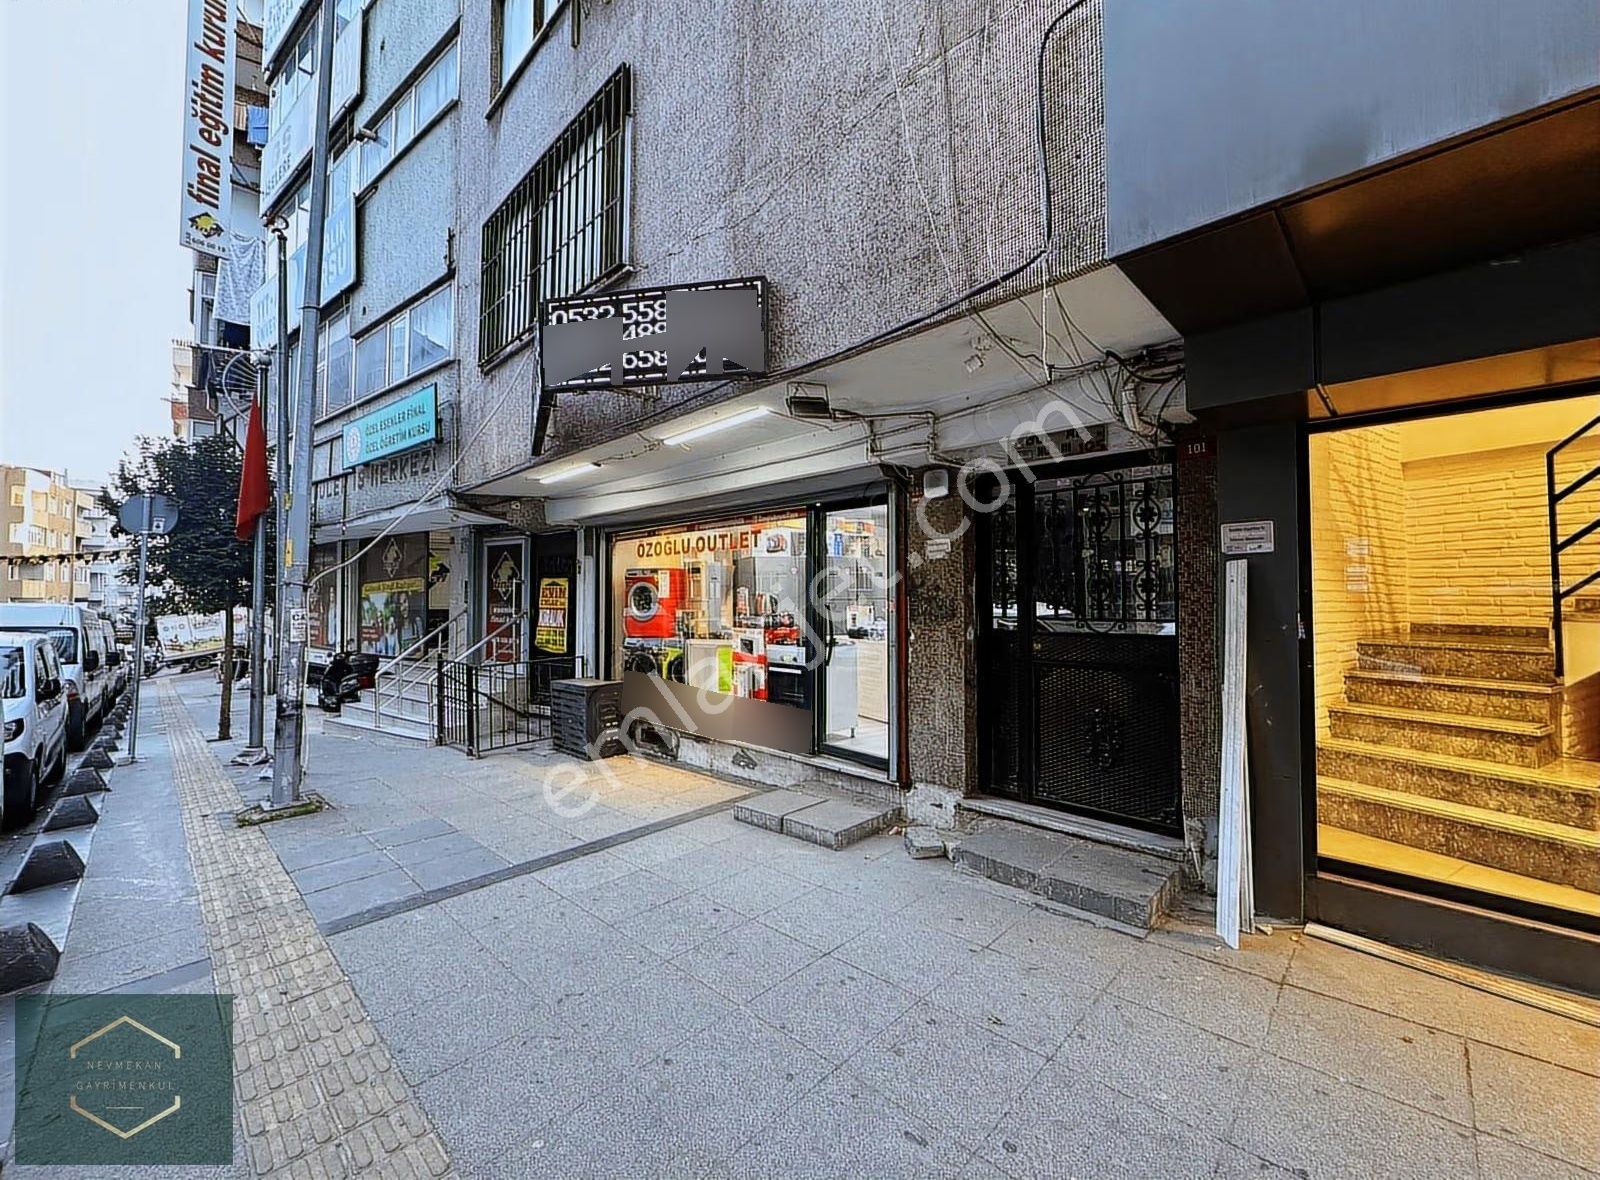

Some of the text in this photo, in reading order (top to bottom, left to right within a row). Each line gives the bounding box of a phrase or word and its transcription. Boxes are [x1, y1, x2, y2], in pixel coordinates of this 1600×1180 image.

[191, 63, 229, 146] eğitim
[187, 143, 221, 209] final
[1188, 442, 1207, 454] 101
[695, 530, 762, 553] OUTLET
